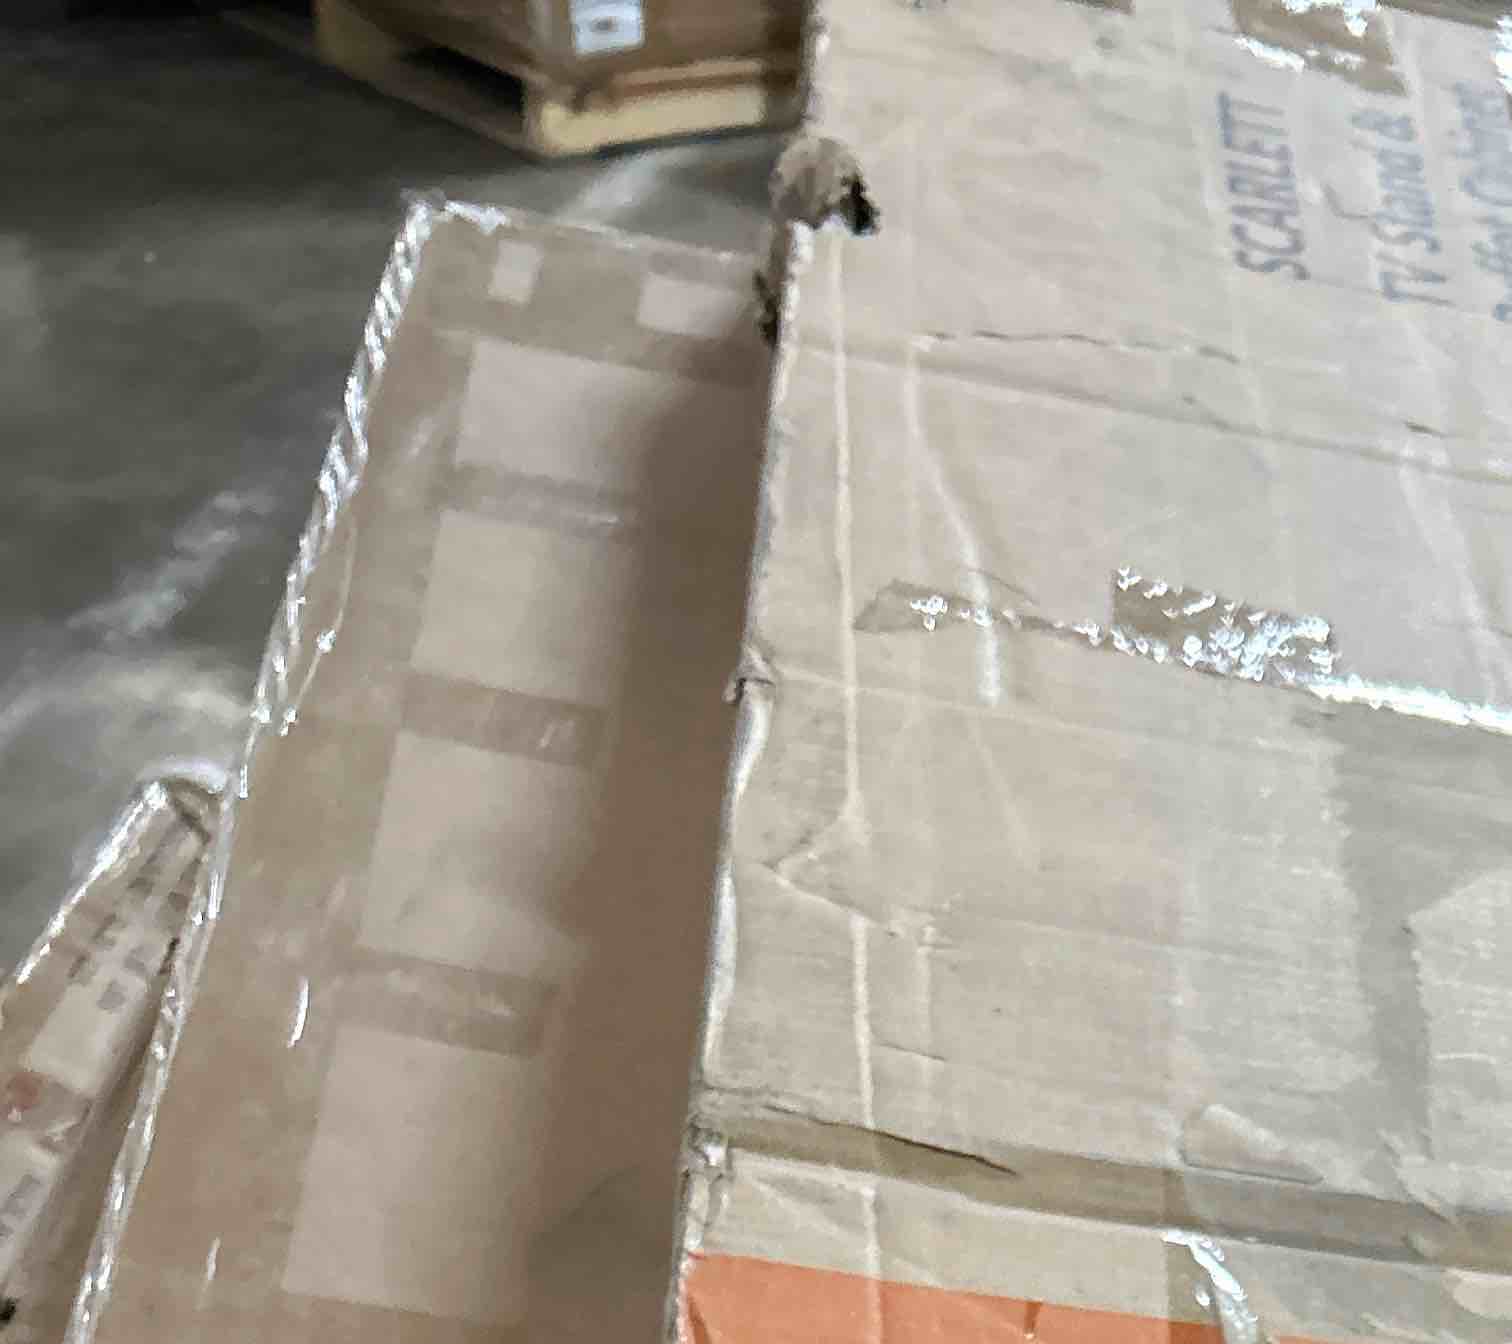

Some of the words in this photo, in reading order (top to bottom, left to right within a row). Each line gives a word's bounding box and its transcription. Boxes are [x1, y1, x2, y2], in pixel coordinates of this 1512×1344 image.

[1217, 90, 1311, 281] SCARLETT
[1374, 147, 1442, 254] Stand
[1374, 251, 1457, 305] TV
